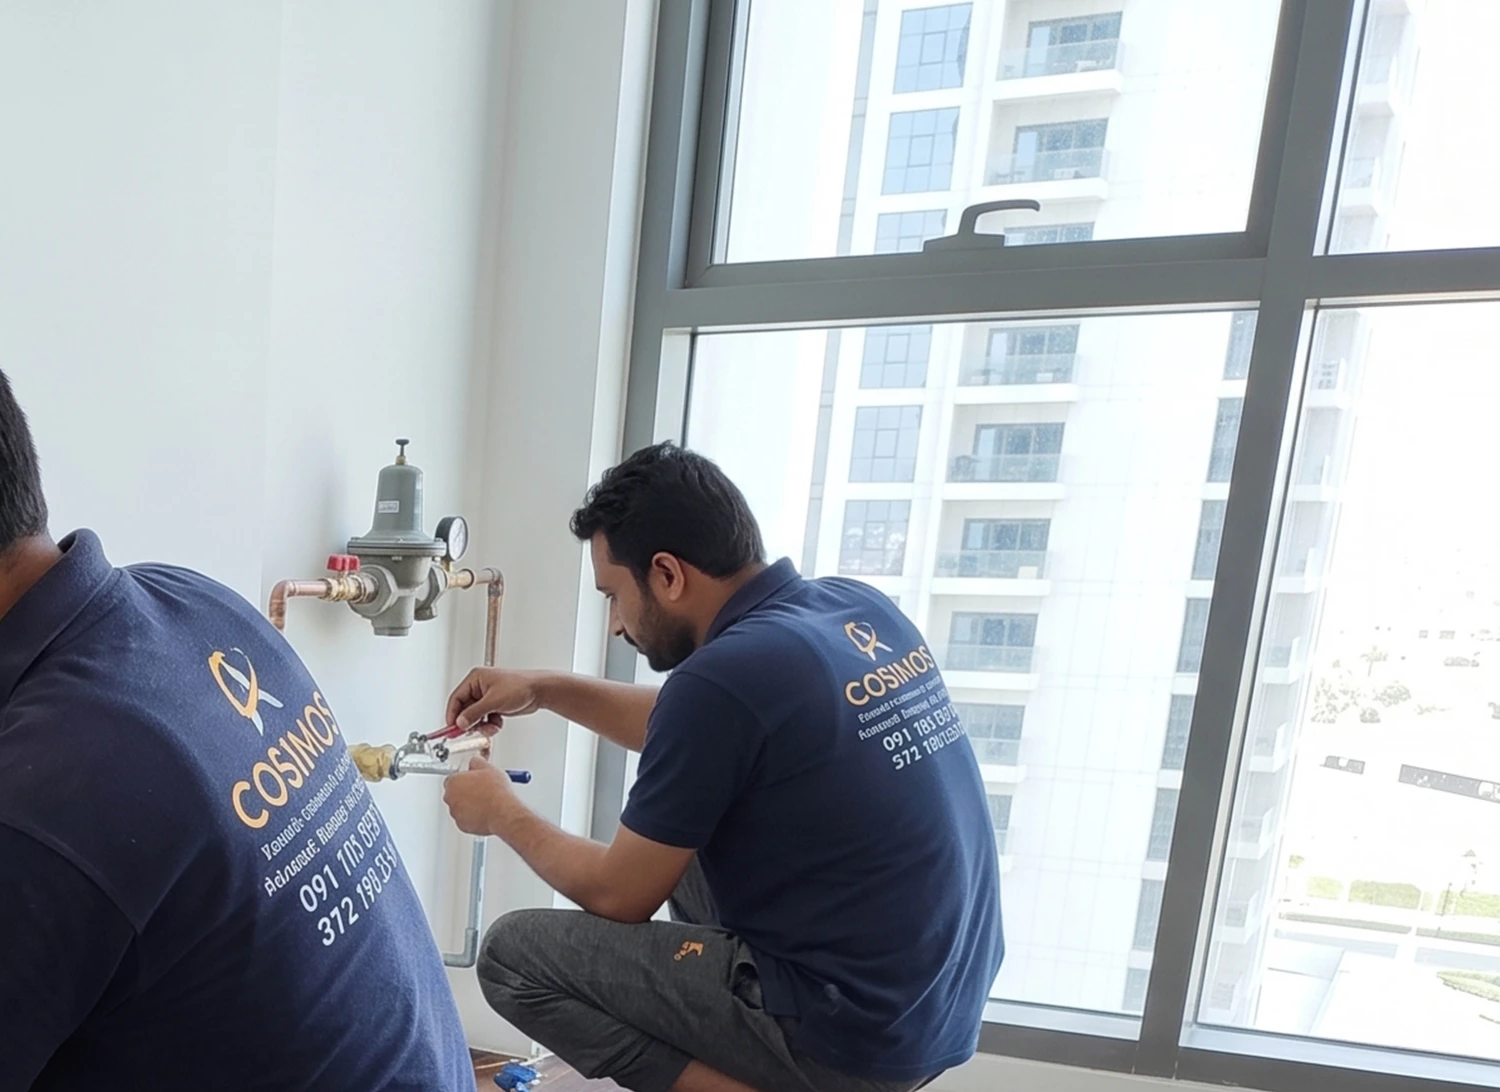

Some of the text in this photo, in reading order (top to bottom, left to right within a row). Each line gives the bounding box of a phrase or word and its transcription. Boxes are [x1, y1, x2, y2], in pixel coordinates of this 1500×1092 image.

[232, 690, 339, 829] COSIMOS
[883, 728, 912, 751] 091
[299, 864, 339, 912] 091
[317, 896, 359, 946] 372
